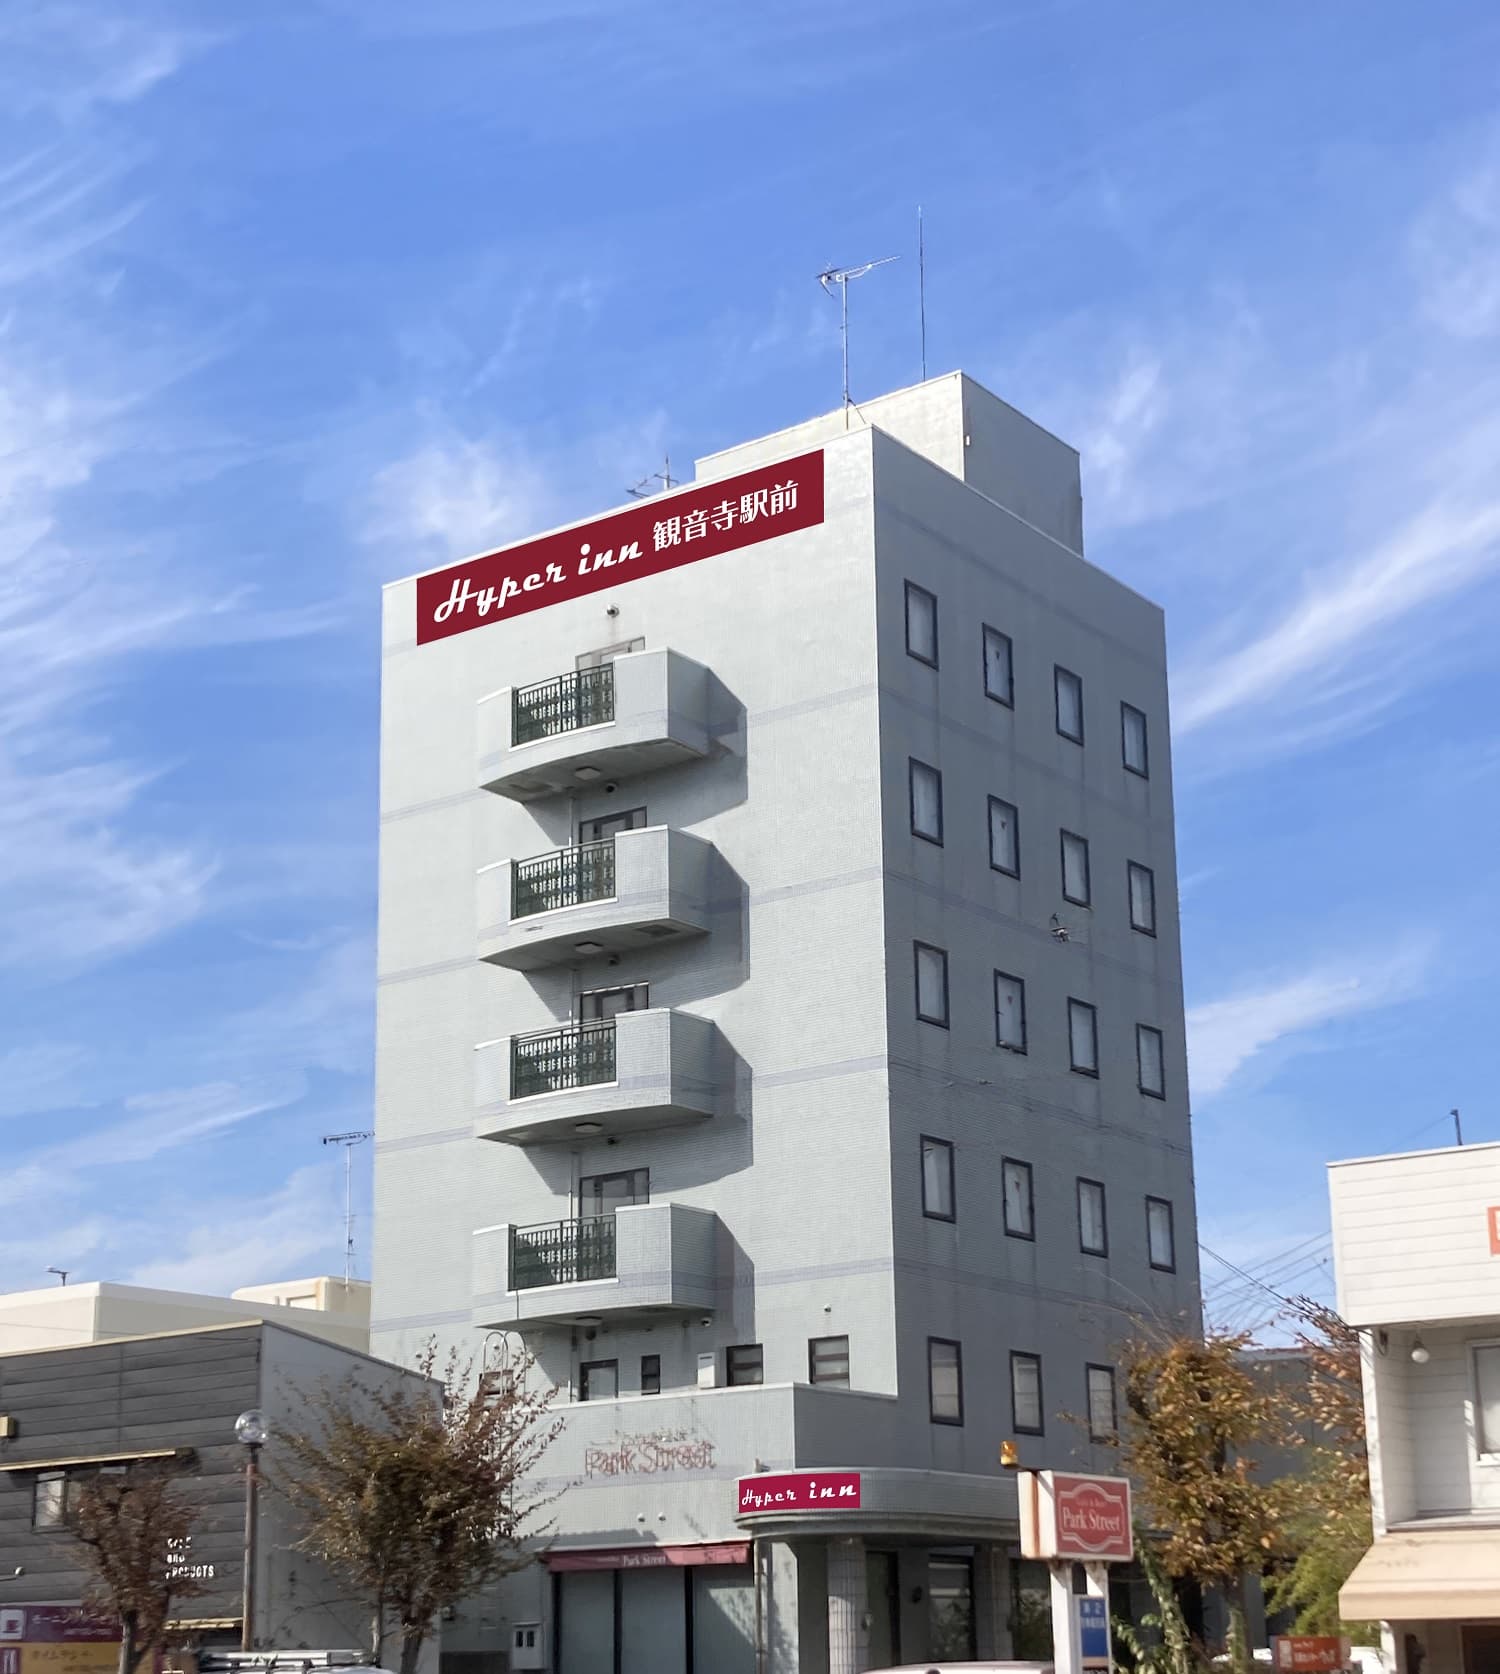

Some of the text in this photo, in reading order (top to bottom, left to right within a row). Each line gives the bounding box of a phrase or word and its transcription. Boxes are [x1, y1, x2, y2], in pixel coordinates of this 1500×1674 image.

[653, 480, 799, 552] 観音寺駅前
[433, 541, 643, 623] Hyper inn
[741, 1481, 857, 1507] Hyper inn
[1063, 1506, 1120, 1532] Park Street
